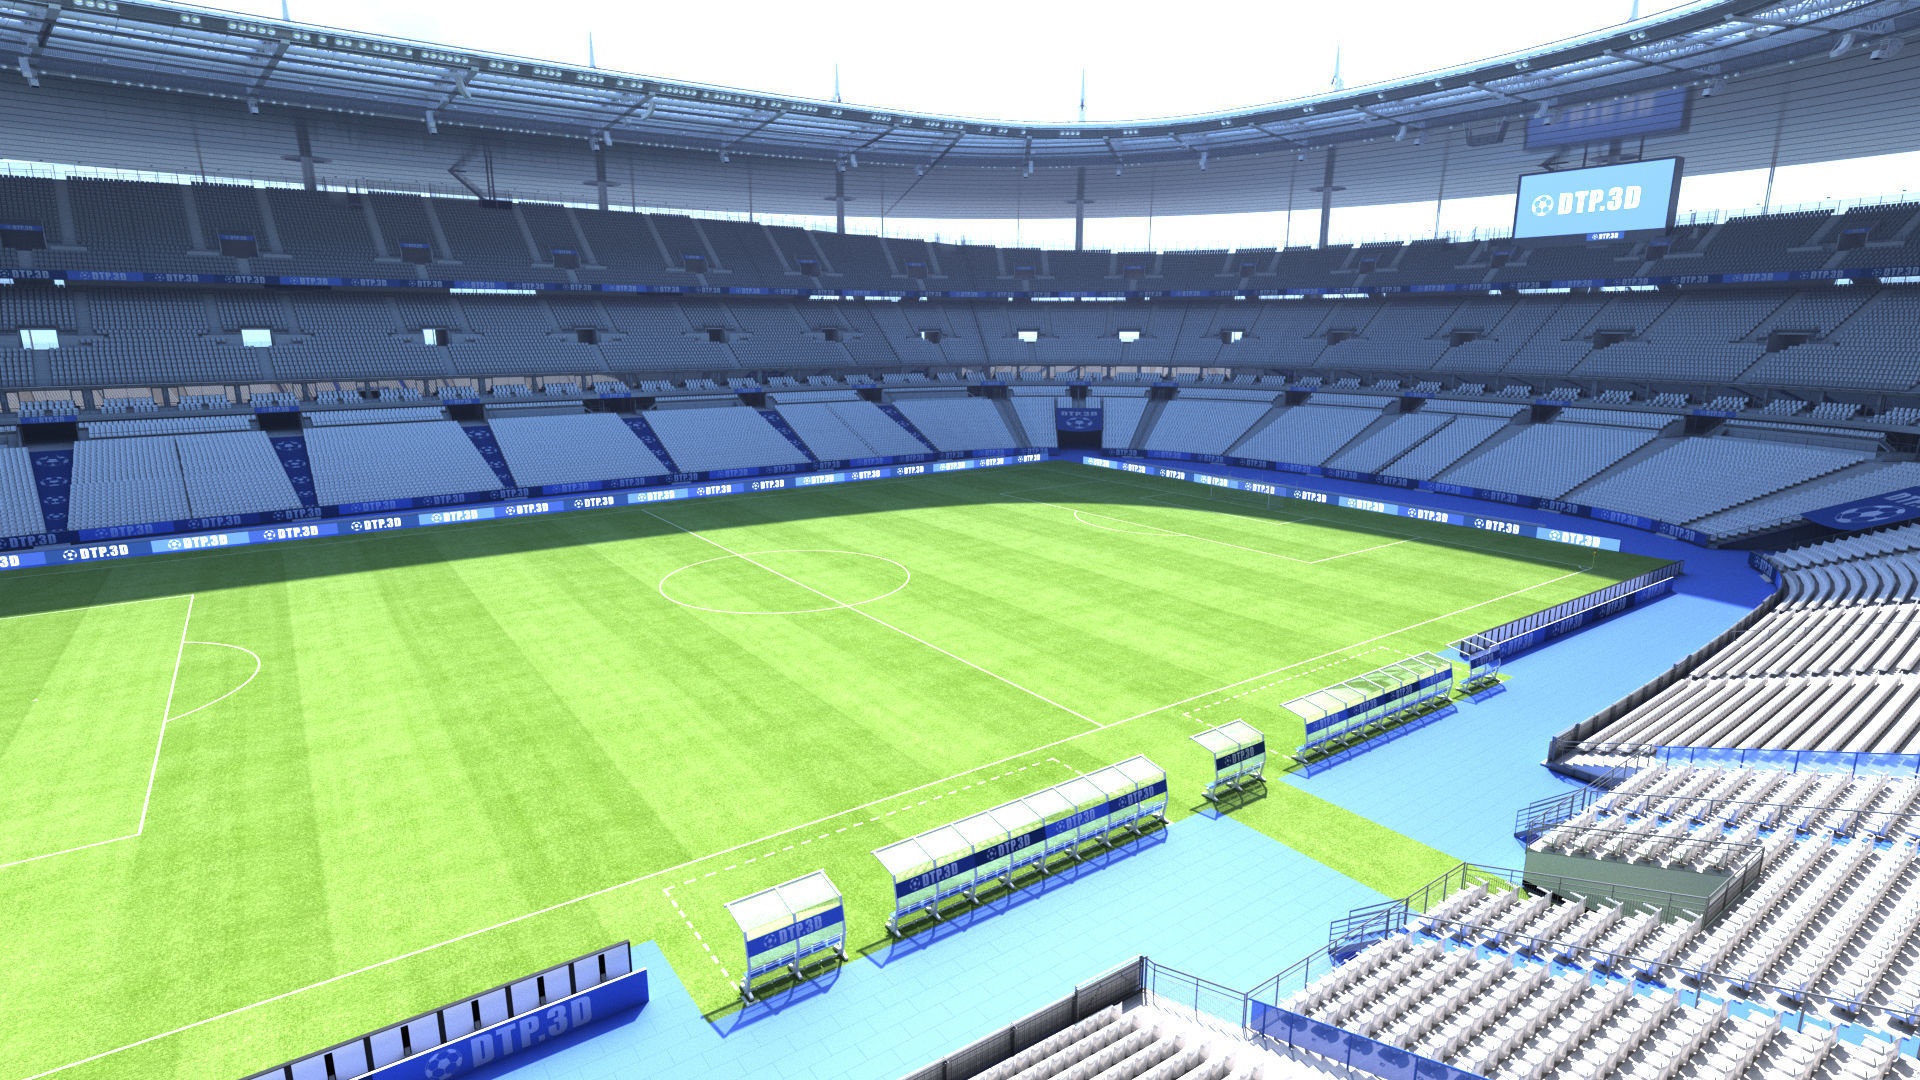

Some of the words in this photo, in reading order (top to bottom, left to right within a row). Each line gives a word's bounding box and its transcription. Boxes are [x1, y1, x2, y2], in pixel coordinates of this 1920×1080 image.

[1558, 185, 1642, 215] DTP.3D
[12, 269, 49, 279] DTP.3D
[92, 272, 127, 280] DTP.3D
[1743, 273, 1774, 281] DTP.3D
[1810, 270, 1843, 279] DTP.3D
[1883, 266, 1920, 276] DTP.3D
[166, 274, 199, 282] DTP.3D
[235, 275, 266, 284] DTP.3D
[760, 480, 784, 489] DTP.3D
[811, 474, 834, 484] DTP.3D
[499, 488, 529, 498] DTP.3D
[562, 482, 589, 492] DTP.3D
[706, 485, 732, 495] DTP.3D
[1252, 484, 1275, 495] DTP.3D
[434, 494, 464, 505] DTP.3D
[647, 490, 675, 501] DTP.3D
[1302, 491, 1327, 503] DTP.3D
[1491, 491, 1518, 503] DTP.3D
[363, 501, 396, 512] DTP.3D
[584, 496, 614, 508] DTP.3D
[1356, 499, 1384, 512] DTP.3D
[1549, 501, 1578, 514] DTP.3D
[285, 508, 321, 520] DTP.3D
[516, 503, 549, 515] DTP.3D
[202, 516, 241, 527] DTP.3D
[443, 510, 478, 522] DTP.3D
[1418, 509, 1448, 522] DTP.3D
[1609, 512, 1638, 525] DTP.3D
[364, 517, 402, 530] DTP.3D
[1485, 519, 1519, 534] DTP.3D
[110, 524, 152, 537] DTP.3D
[277, 526, 318, 539] DTP.3D
[1669, 525, 1695, 541] DTP.3D
[9, 534, 56, 547] DTP.3D
[182, 535, 228, 548] DTP.3D
[1561, 530, 1600, 547] DTP.3D
[80, 544, 128, 560] DTP.3D
[1232, 746, 1255, 764] DTP.3D
[1127, 786, 1154, 805] DTP.3D
[1065, 810, 1096, 831] DTP.3D
[998, 832, 1031, 856] DTP.3D
[921, 862, 959, 887] DTP.3D
[778, 916, 823, 943] DTP.3D
[471, 996, 592, 1068] DTP.3D
